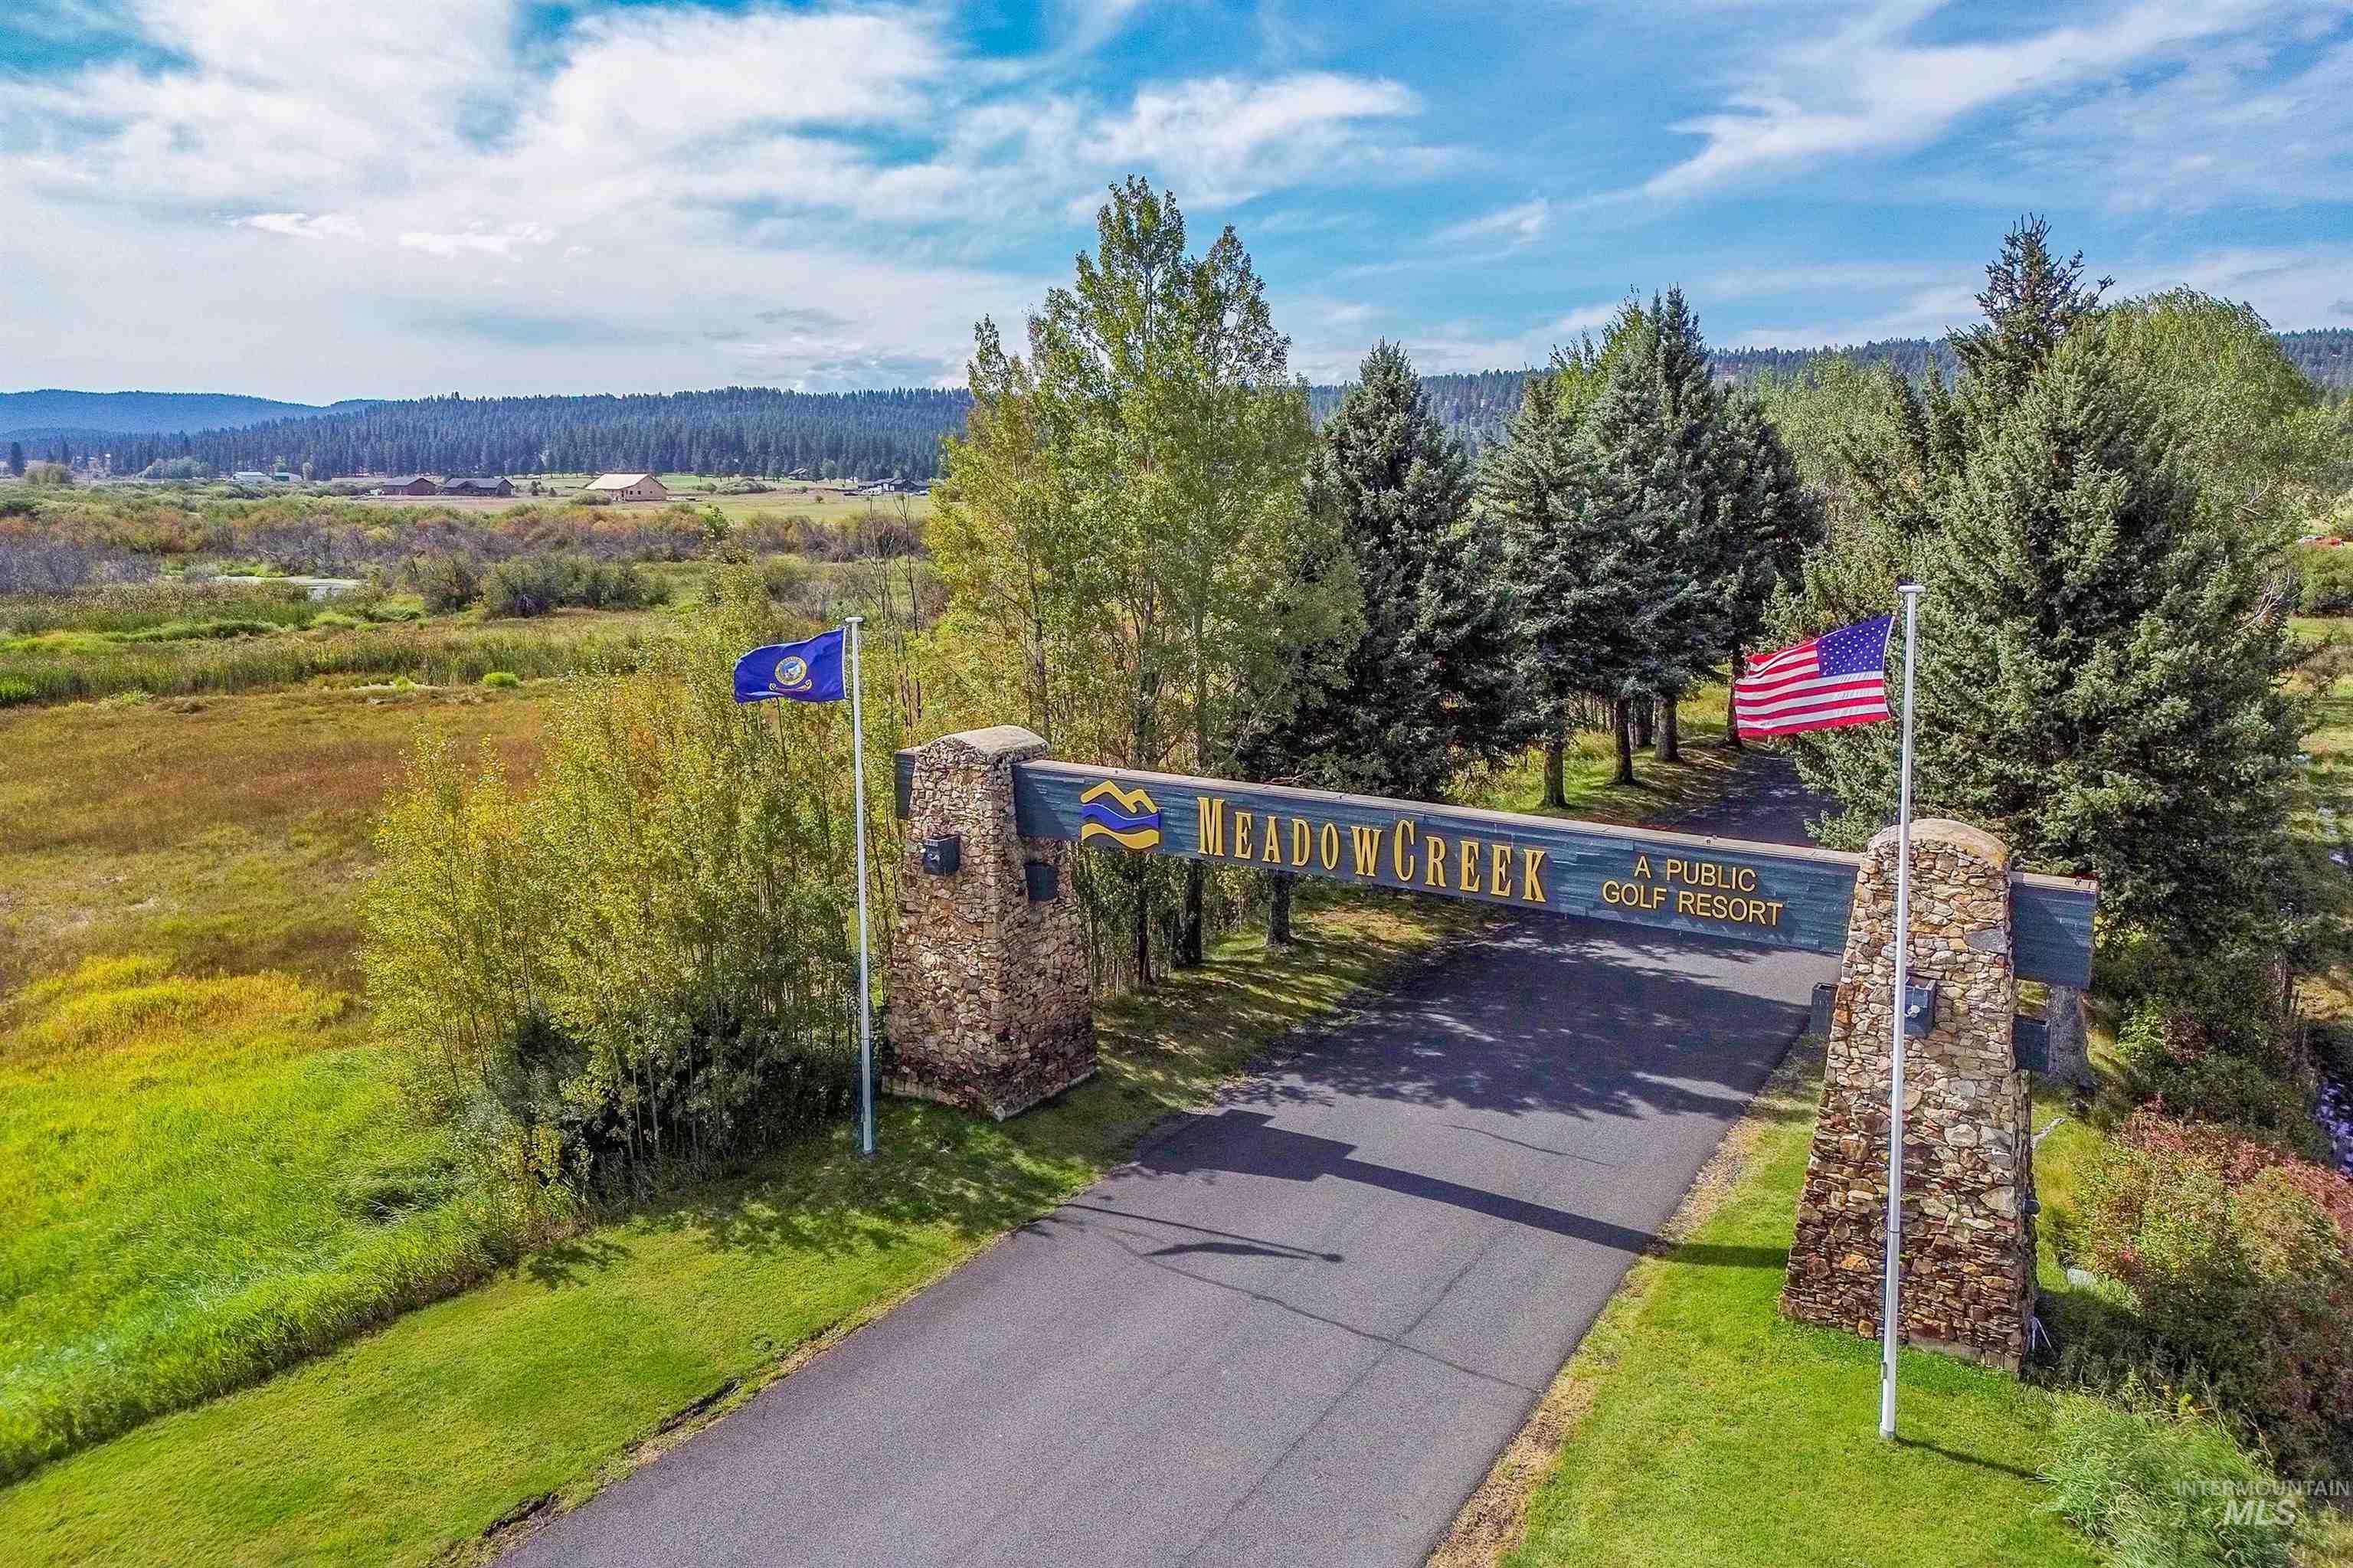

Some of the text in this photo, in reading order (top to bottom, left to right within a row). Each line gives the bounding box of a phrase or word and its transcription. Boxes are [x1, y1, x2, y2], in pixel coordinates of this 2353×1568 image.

[1633, 855, 1756, 892] A PUBLIC
[1602, 880, 1784, 926] GOLF RESORT
